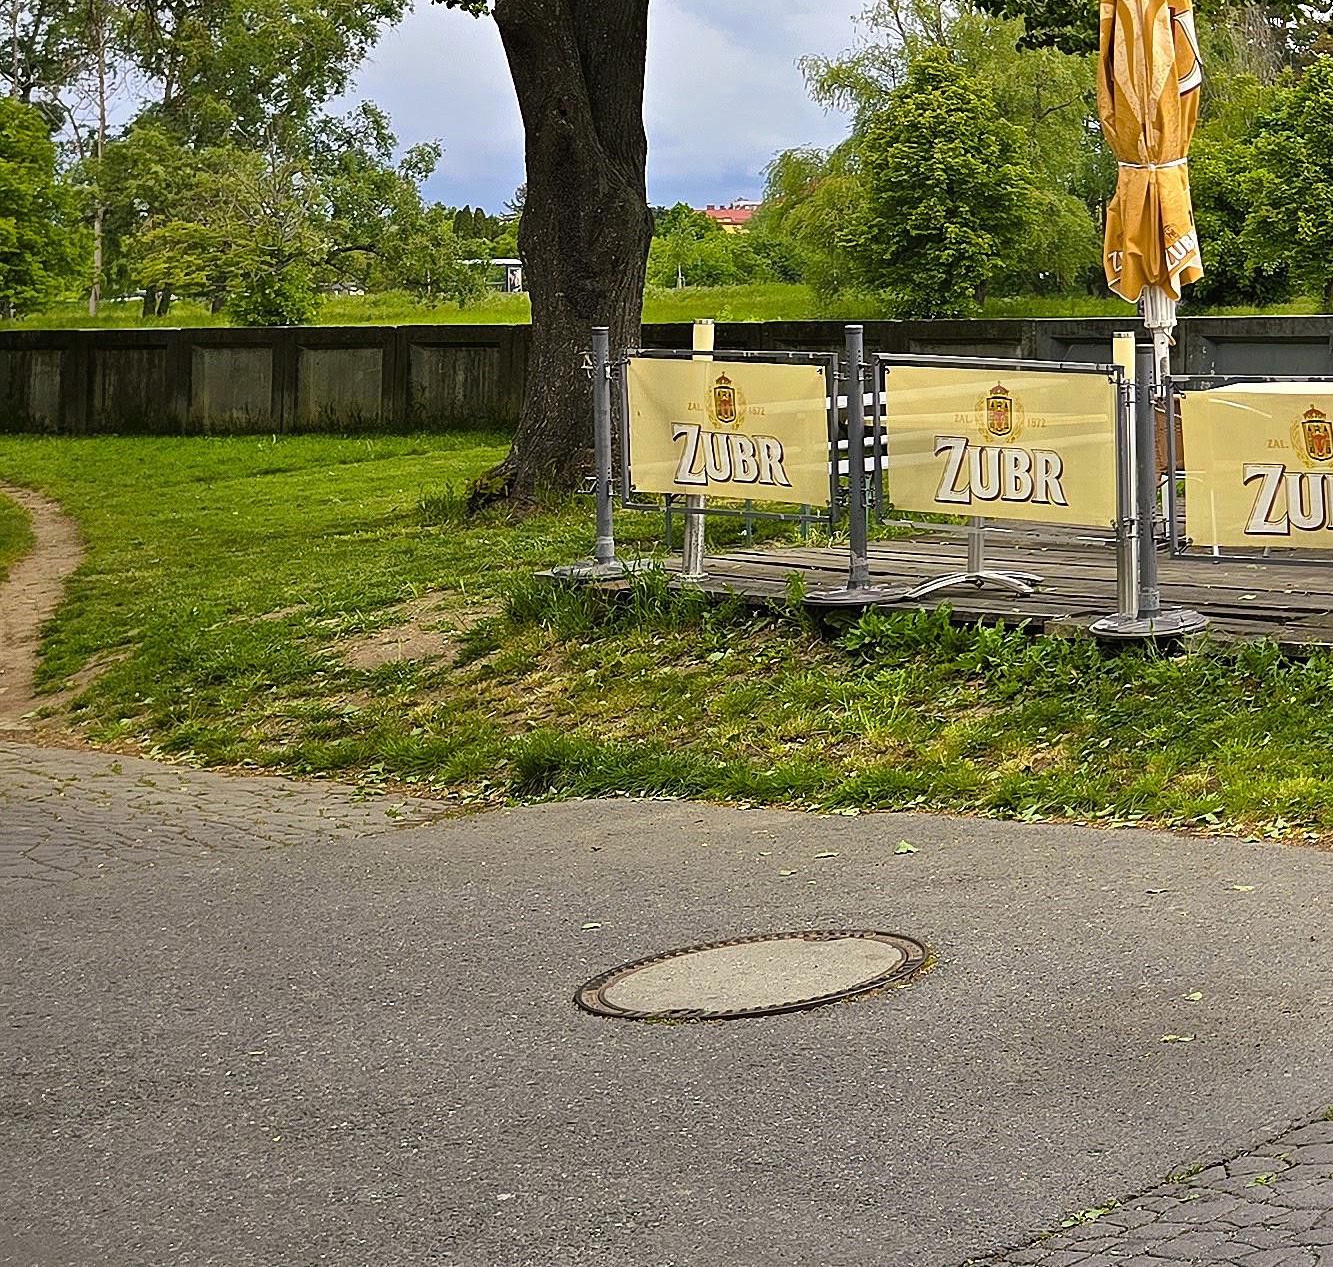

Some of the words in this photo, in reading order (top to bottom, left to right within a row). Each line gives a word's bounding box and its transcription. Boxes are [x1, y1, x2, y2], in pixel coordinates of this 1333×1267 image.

[1027, 418, 1047, 428] 1872
[671, 422, 793, 488] ZUBR
[1267, 439, 1288, 449] ZAL.
[934, 435, 1069, 507] ZUBR
